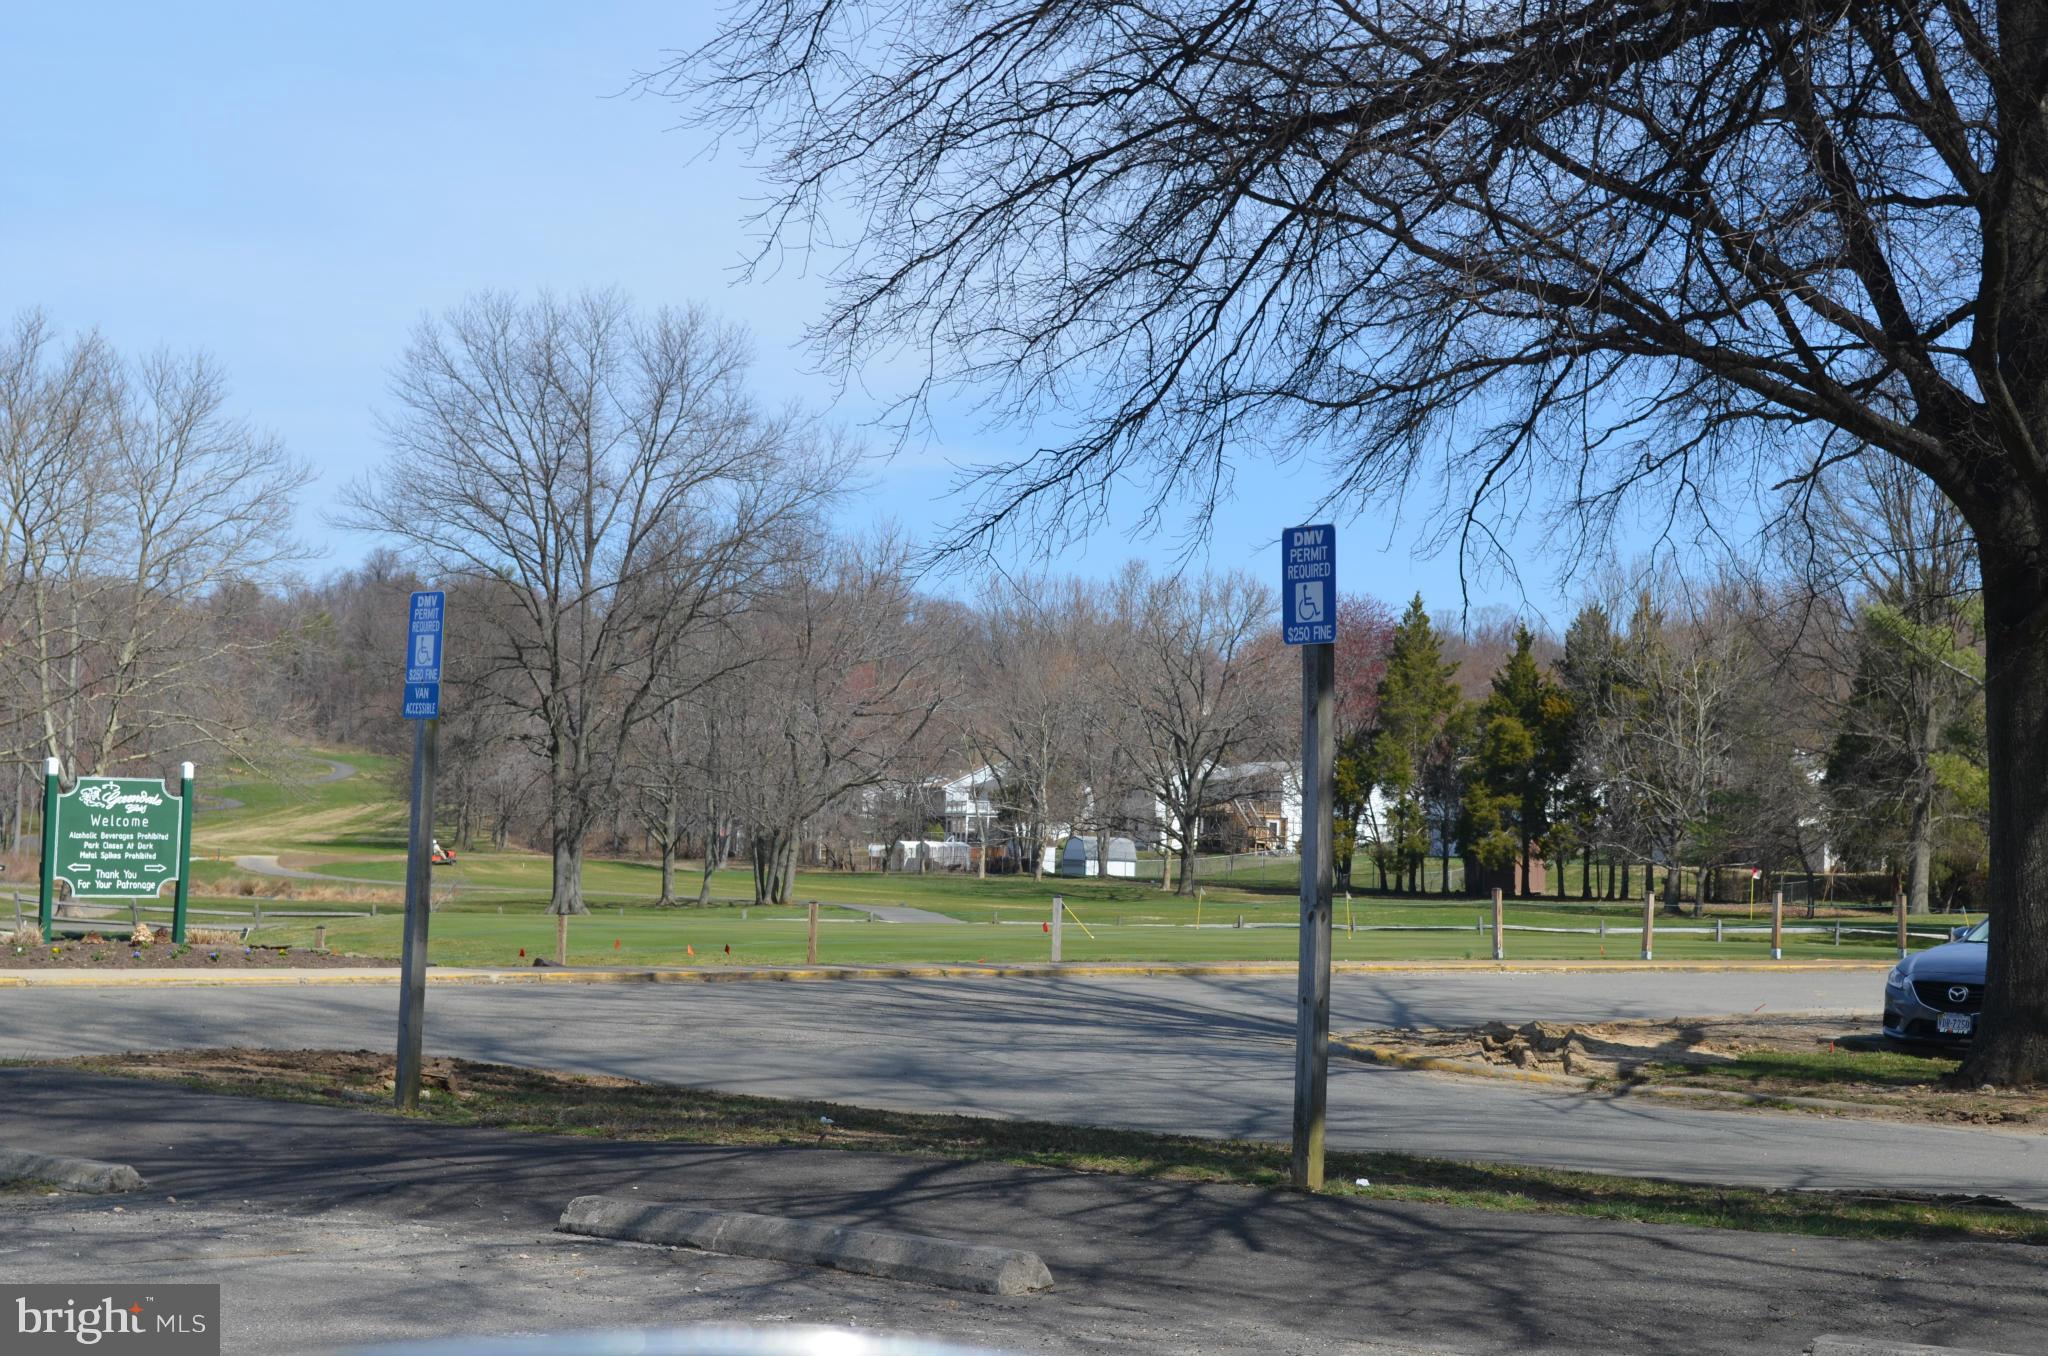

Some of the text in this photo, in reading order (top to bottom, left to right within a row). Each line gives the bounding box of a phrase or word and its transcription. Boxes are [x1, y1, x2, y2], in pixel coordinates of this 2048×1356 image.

[1293, 530, 1324, 547] DMV
[1290, 546, 1328, 563] PERMIT
[1287, 562, 1331, 580] REQUIRED
[417, 595, 438, 607] DMV
[414, 608, 439, 619] PERMIT
[412, 620, 440, 632] REQUIRED
[1287, 625, 1332, 642] $250 FINE
[409, 668, 438, 681] $250 FINE
[414, 687, 429, 699] VAN
[405, 702, 436, 714] ACCESSIBLE
[90, 814, 149, 828] Welcome
[100, 832, 134, 841] Beverages
[137, 832, 169, 840] Prohibited
[138, 842, 153, 850] Dark
[80, 851, 157, 860] Metal Spikes Prohibited
[96, 869, 137, 879] Thank You
[77, 879, 156, 891] For Your Patronage
